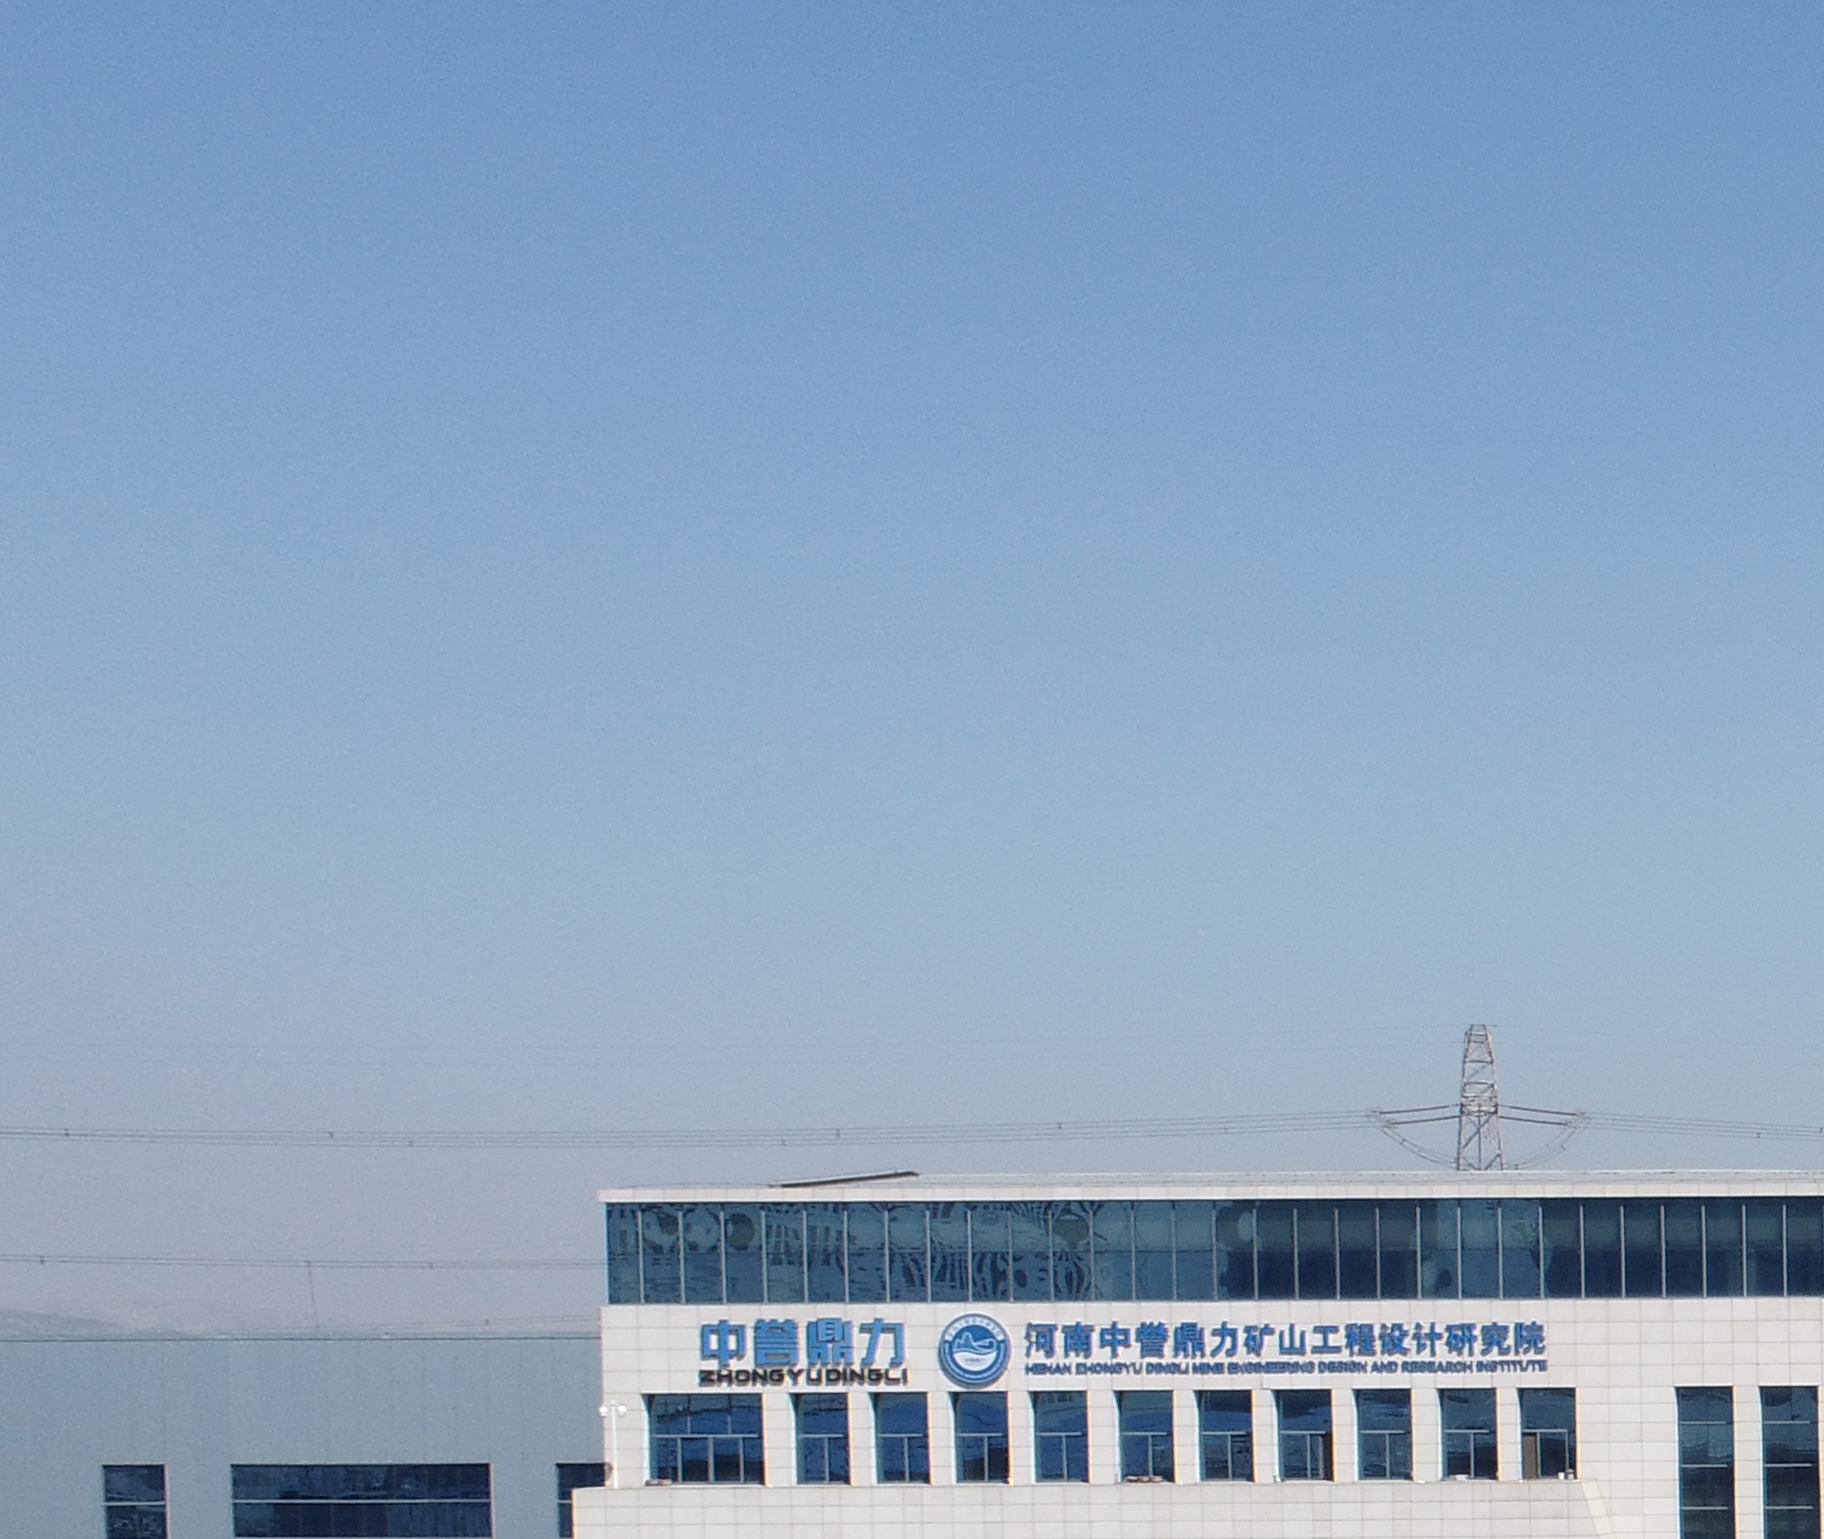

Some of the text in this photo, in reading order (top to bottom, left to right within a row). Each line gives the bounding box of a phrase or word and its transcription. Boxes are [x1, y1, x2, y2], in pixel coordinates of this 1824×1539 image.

[701, 1317, 905, 1366] 中誉鼎力
[1025, 1320, 1547, 1358] 河南中誉鼎力矿山工程设计研究院
